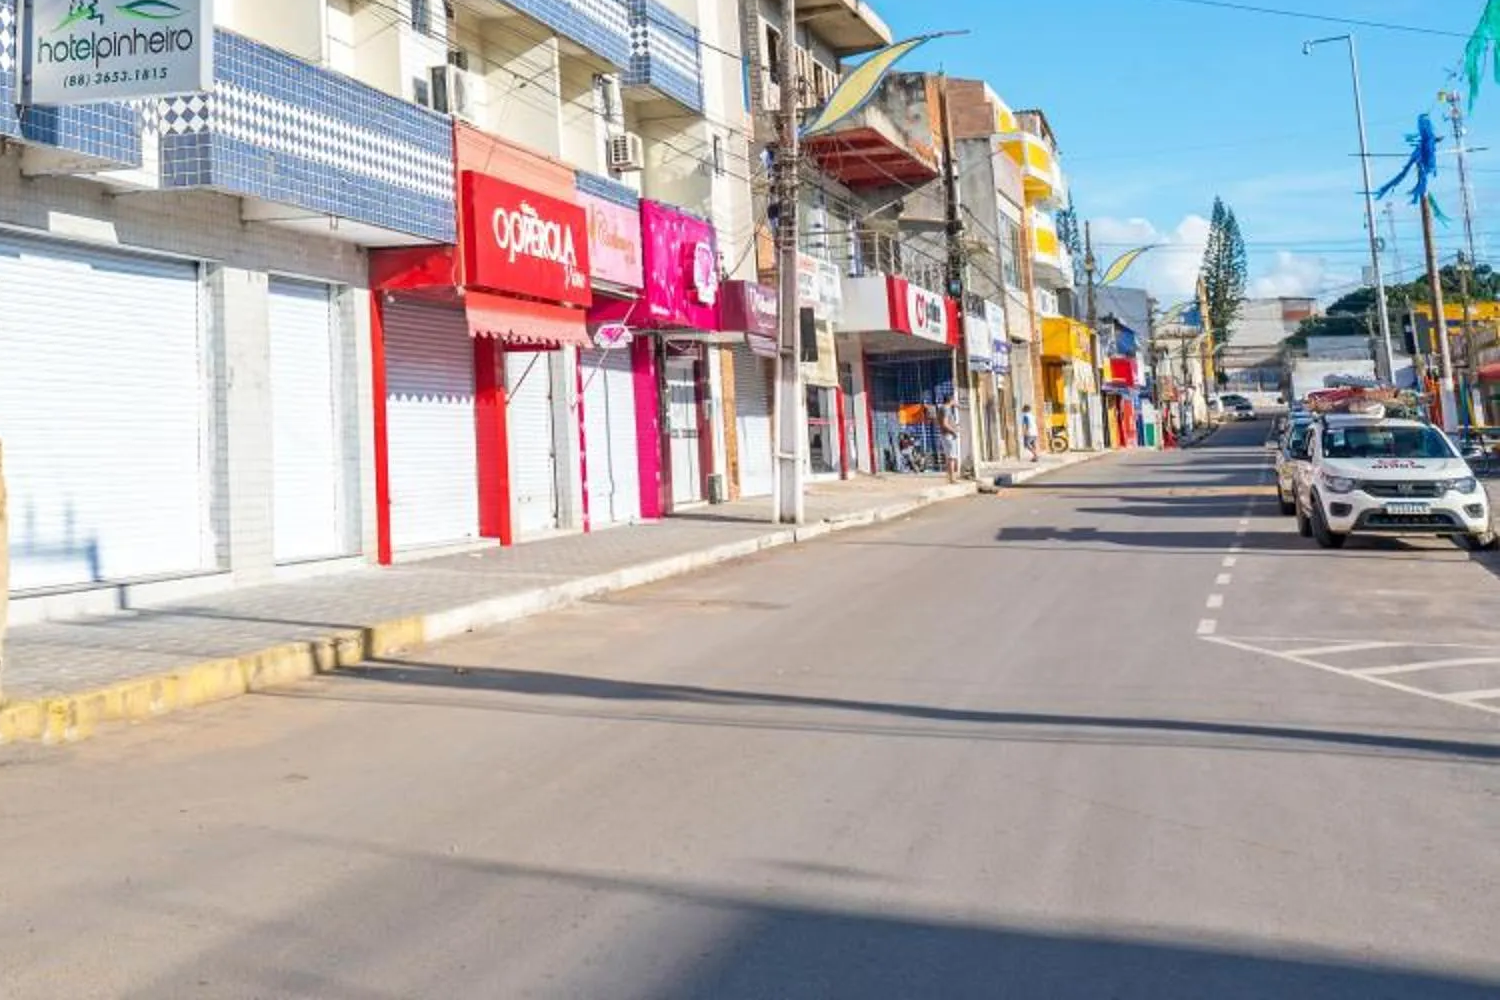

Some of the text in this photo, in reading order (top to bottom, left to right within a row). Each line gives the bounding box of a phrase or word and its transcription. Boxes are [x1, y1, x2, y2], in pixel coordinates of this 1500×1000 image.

[37, 25, 193, 69] hotelpinheiro
[63, 67, 169, 88] (88) 3653.1815
